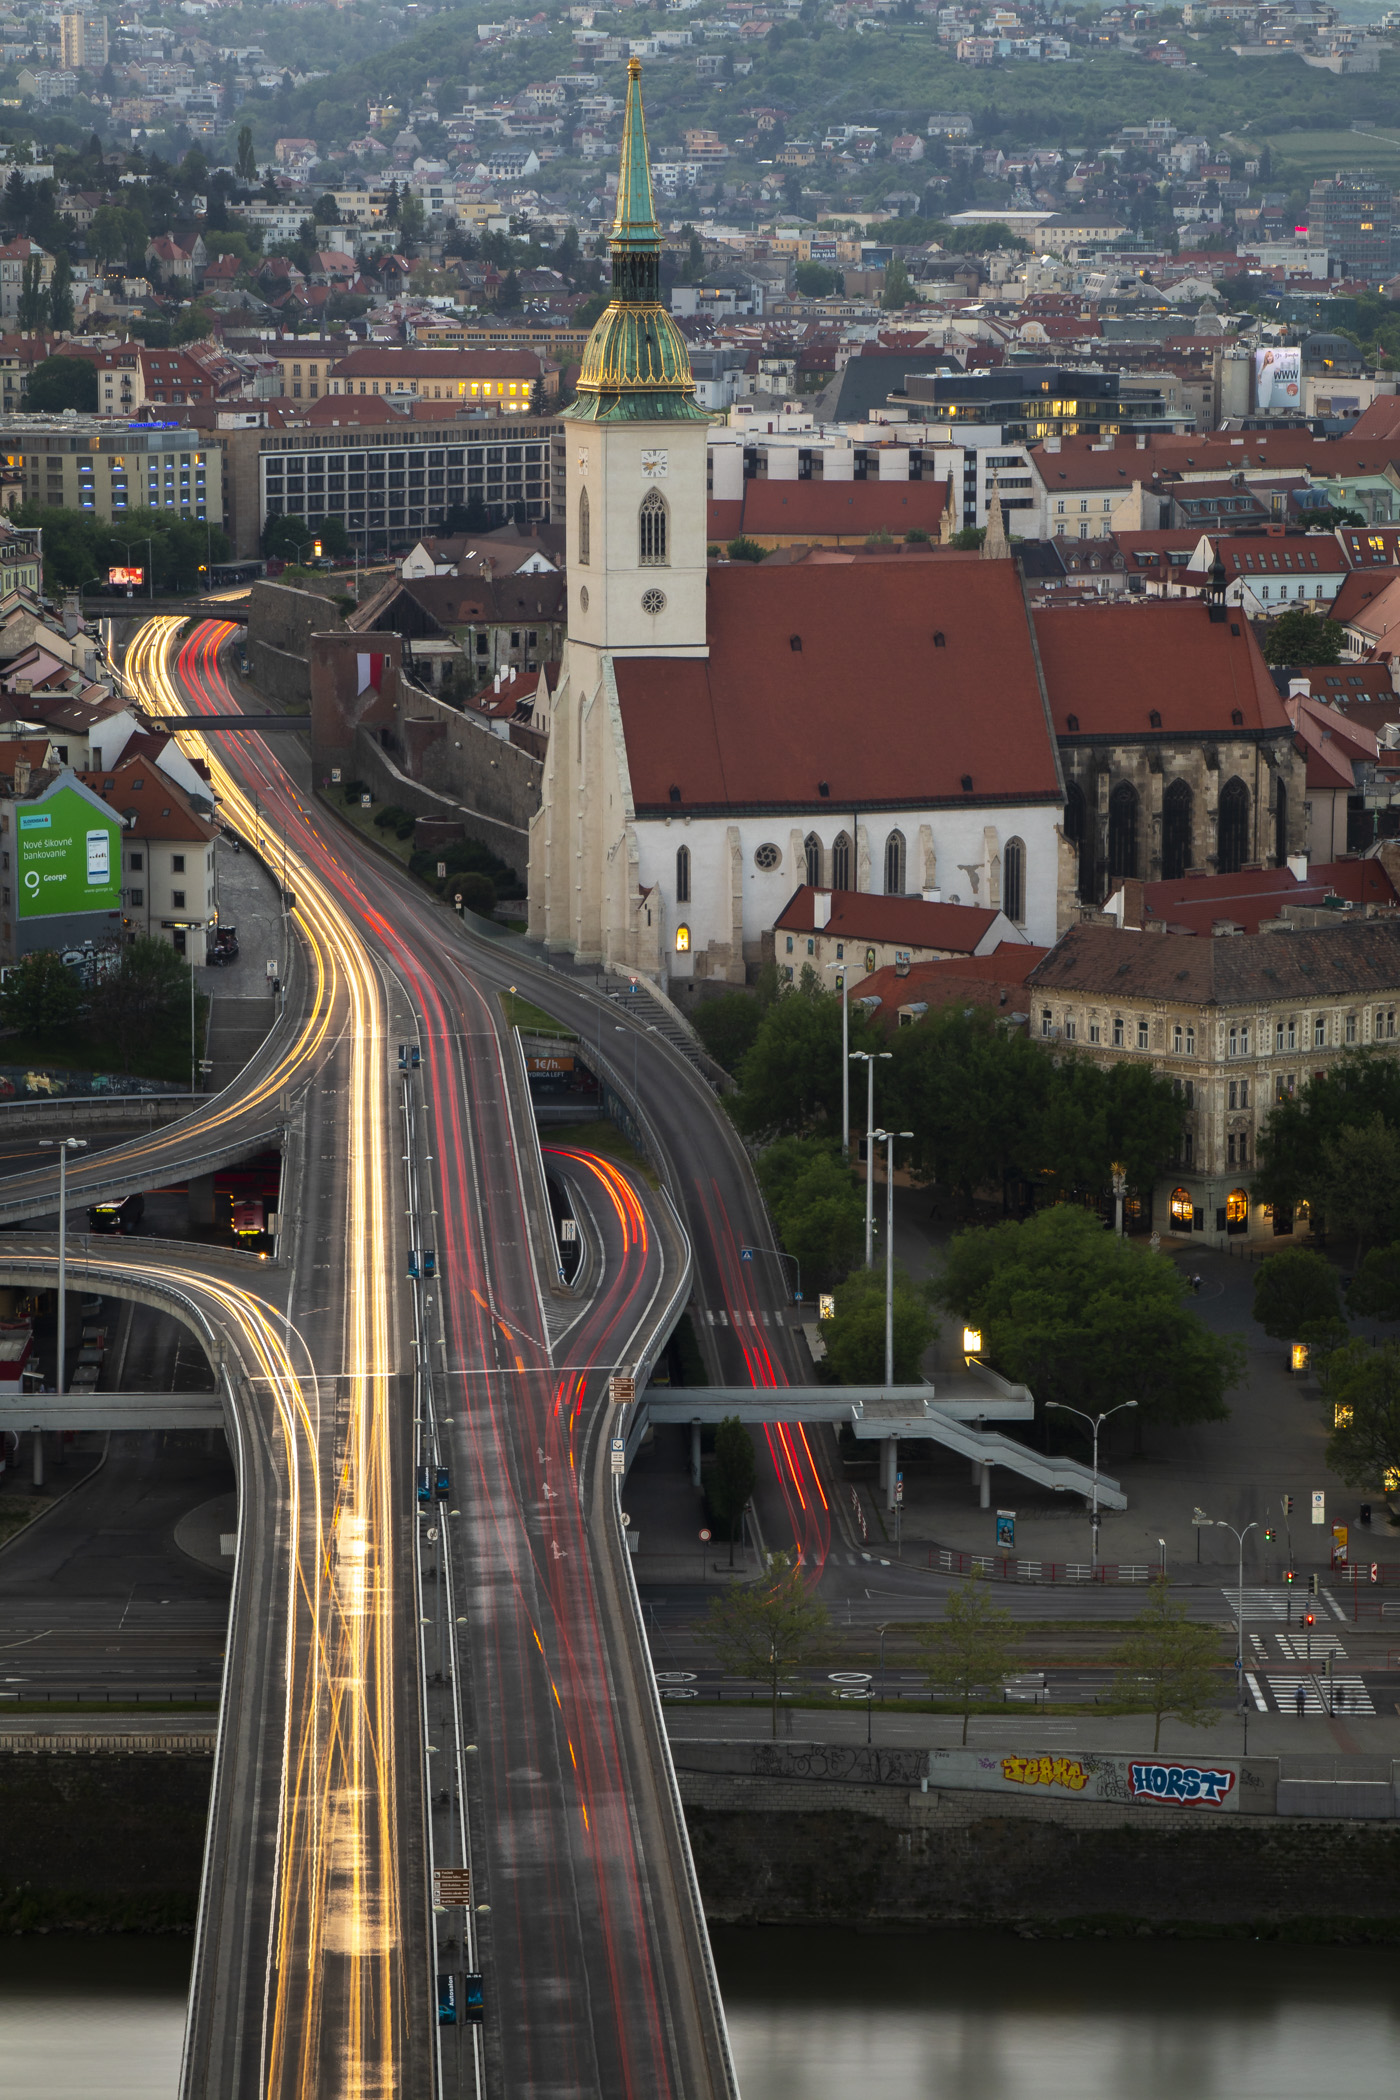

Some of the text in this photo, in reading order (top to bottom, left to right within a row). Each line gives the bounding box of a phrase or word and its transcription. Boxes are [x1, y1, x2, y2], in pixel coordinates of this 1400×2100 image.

[23, 837, 72, 849] Nové šikovné
[23, 849, 66, 860] bankovanie
[43, 874, 67, 882] George
[1132, 1764, 1231, 1802] HORST
